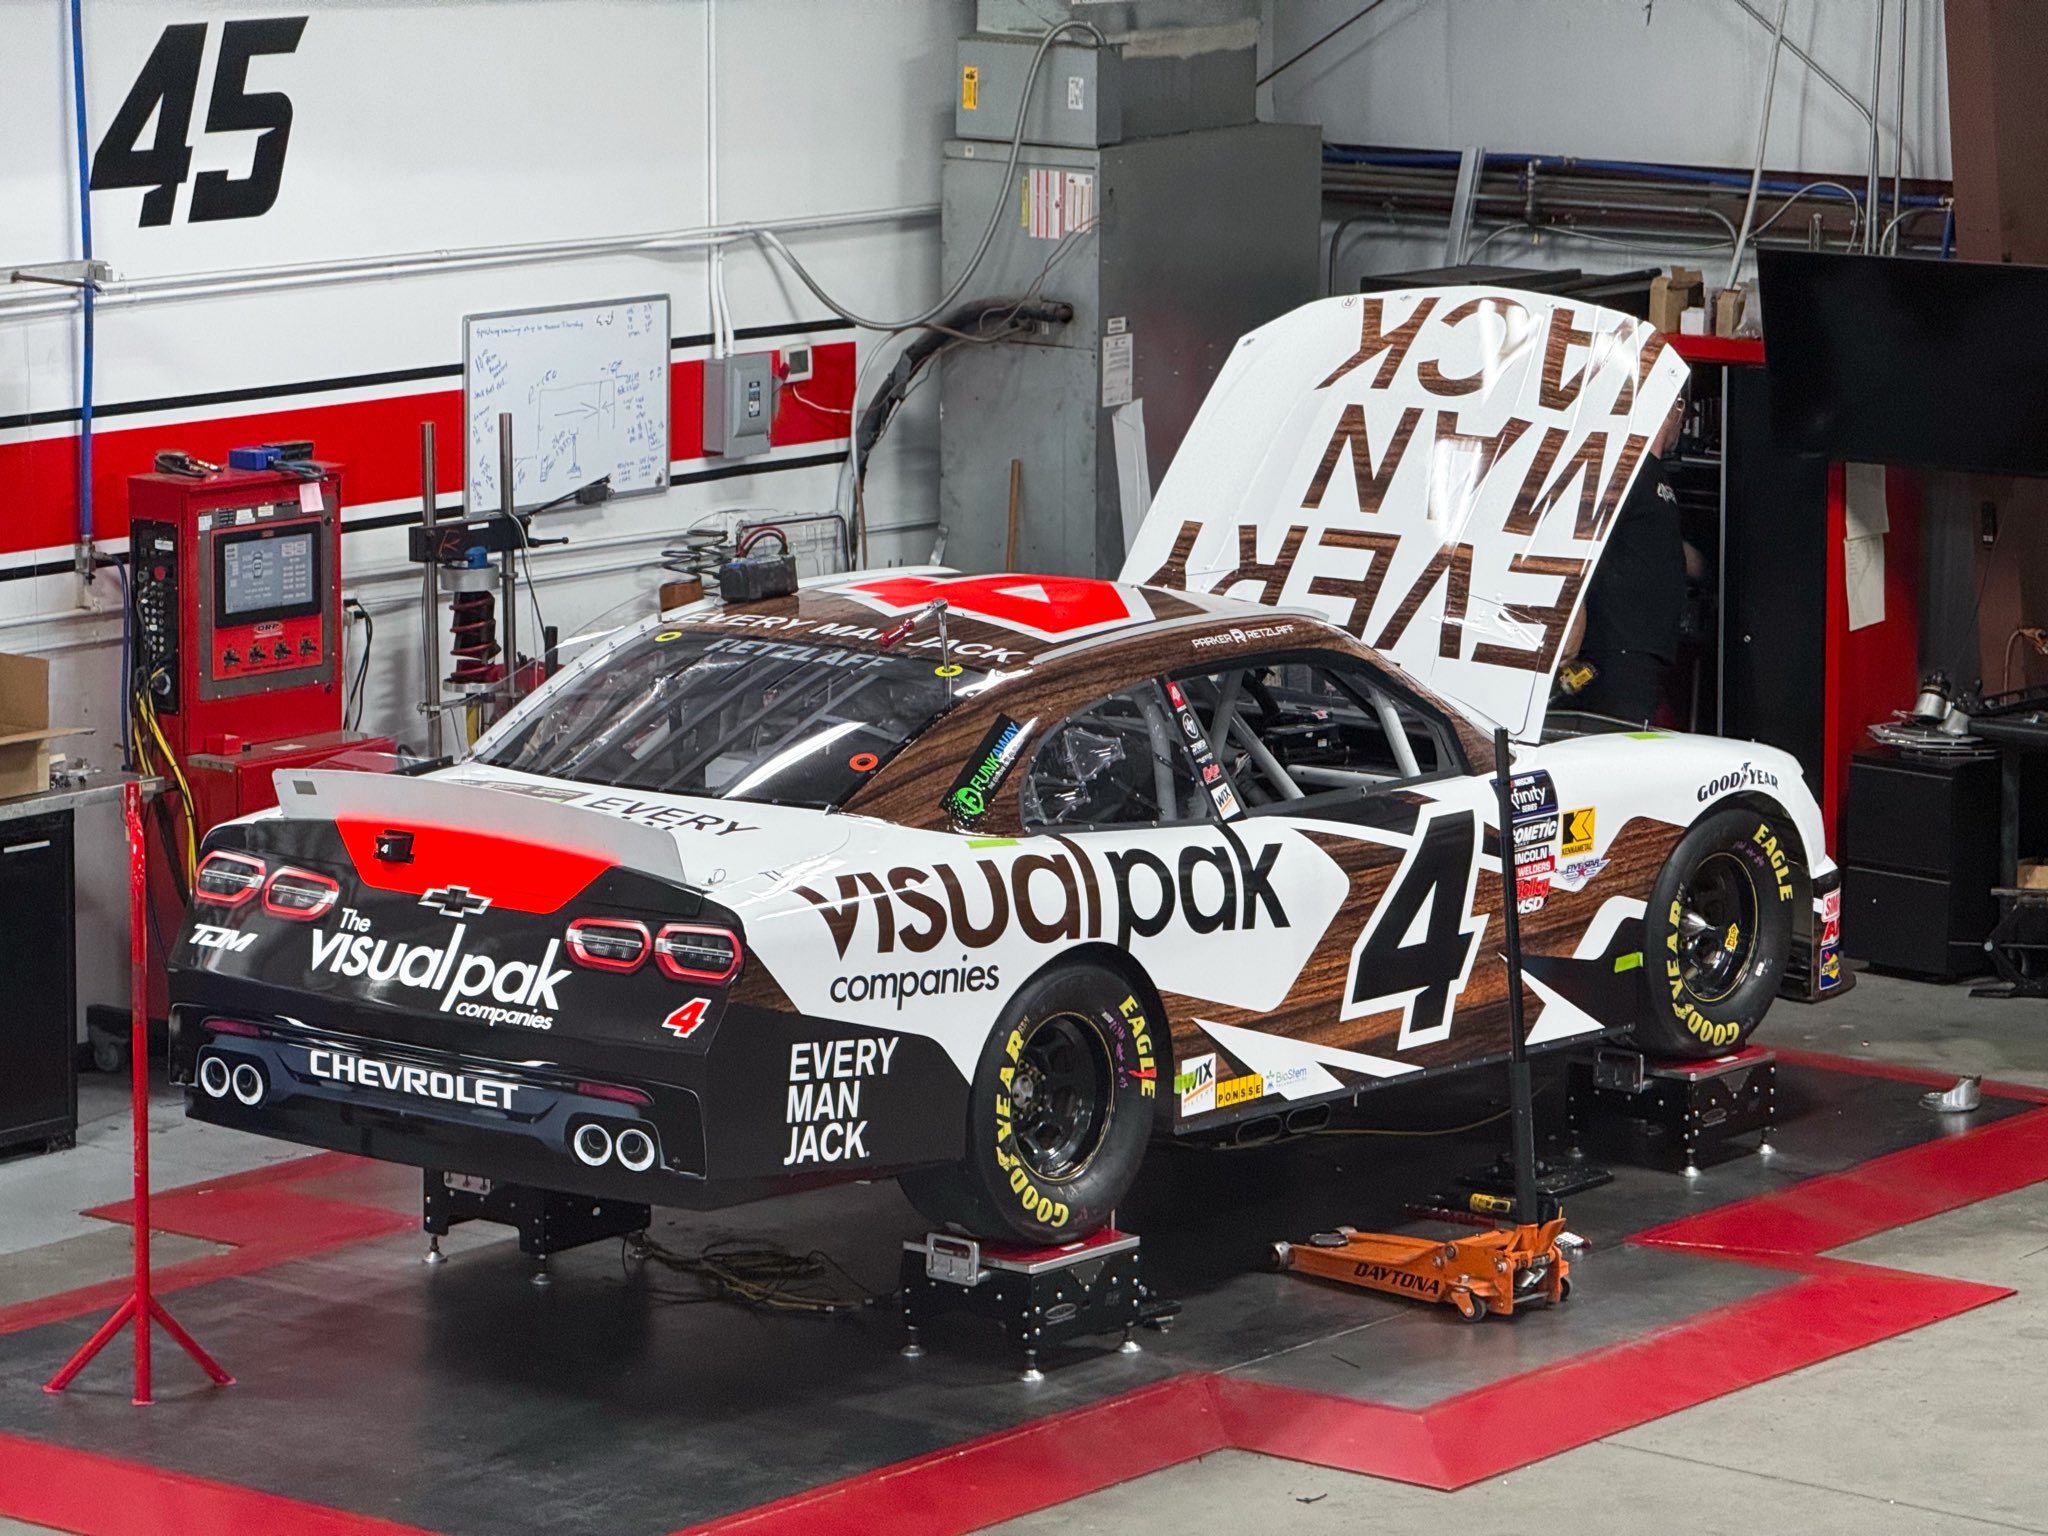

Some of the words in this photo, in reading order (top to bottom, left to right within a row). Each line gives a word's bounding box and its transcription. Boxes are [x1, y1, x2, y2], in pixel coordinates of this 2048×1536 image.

[90, 15, 309, 228] 45
[1315, 296, 1668, 416] JACK
[1301, 403, 1649, 542] MAN
[1143, 519, 1593, 674] EVERY
[676, 612, 818, 630] EVERY
[906, 636, 1026, 664] JACK
[704, 638, 896, 668] RETZLAFF
[1192, 633, 1233, 649] PARKER
[1247, 625, 1295, 639] RETZLAFF
[970, 721, 1020, 792] FUNKAWAY
[584, 797, 760, 836] EVERY
[1215, 786, 1232, 808] WIX
[1514, 847, 1548, 865] INCOLN
[1517, 861, 1551, 878] WELDERS
[1753, 823, 1793, 901] EAGLE
[340, 908, 372, 933] The
[1345, 804, 1482, 1042] 4
[830, 954, 1000, 1011] companies
[456, 1000, 554, 1031] companies
[661, 997, 712, 1038] 4
[789, 1036, 899, 1082] EVERY
[1119, 995, 1158, 1099] EAGLE
[309, 1050, 519, 1110] CHEVROLET
[1217, 1084, 1261, 1104] PONSSE
[1275, 1067, 1307, 1084] BioStem
[785, 1080, 860, 1124] MAN
[1354, 1261, 1440, 1295] DAYTONA
